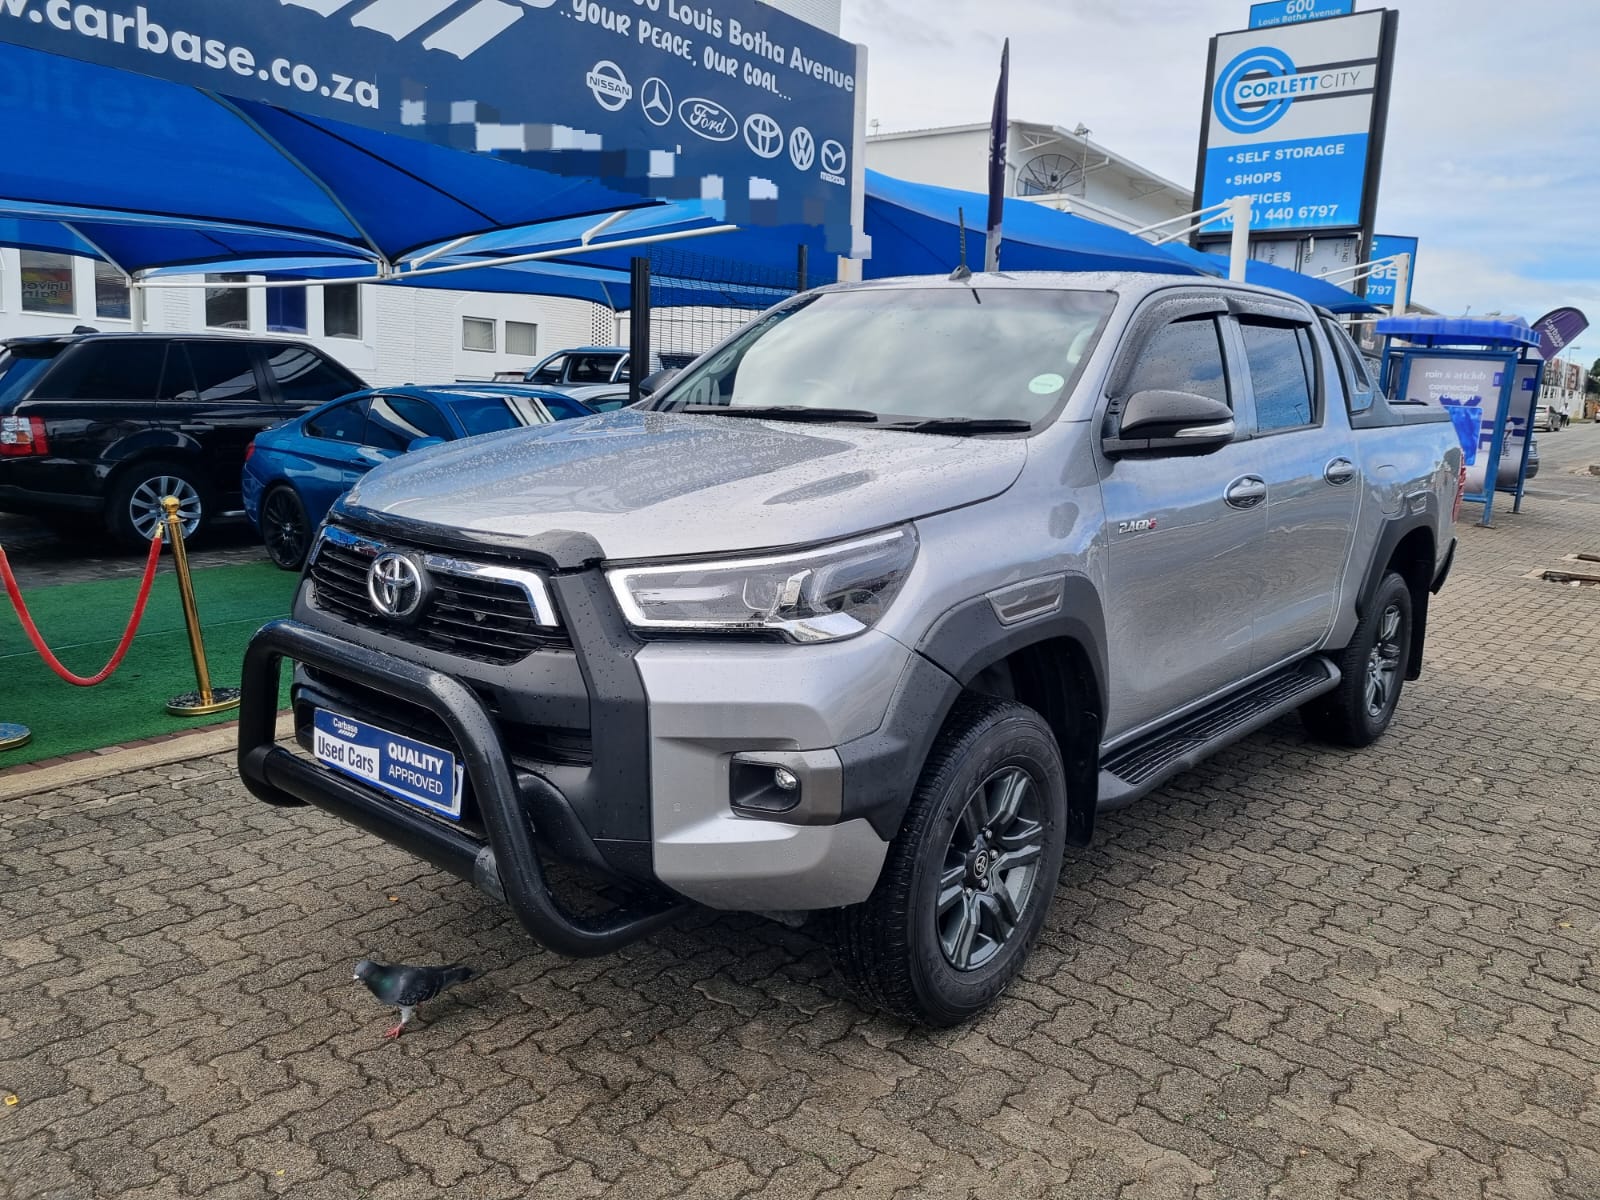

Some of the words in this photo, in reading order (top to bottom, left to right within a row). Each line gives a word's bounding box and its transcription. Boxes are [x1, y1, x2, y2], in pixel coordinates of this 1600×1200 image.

[1258, 16, 1280, 26] Louis
[1282, 13, 1307, 23] Botha
[1309, 8, 1342, 19] Avenue
[1286, 0, 1315, 14] 600
[638, 18, 697, 67] PEACE,
[703, 46, 739, 78] OUR
[669, 0, 723, 39] Louis
[729, 18, 785, 65] Botha
[789, 46, 856, 93] Avenue
[589, 75, 631, 97] NISSAN
[690, 102, 727, 135] Ford
[1236, 150, 1271, 164] SELF
[1275, 143, 1346, 161] STORAGE
[1234, 171, 1282, 185] SHOPS
[1264, 207, 1294, 221] 440
[1298, 204, 1339, 218] 6797
[333, 717, 359, 734] Carbase
[318, 735, 345, 763] Used
[347, 746, 375, 774] Cars
[388, 742, 444, 775] QUALITY
[388, 764, 444, 796] APPROVED
